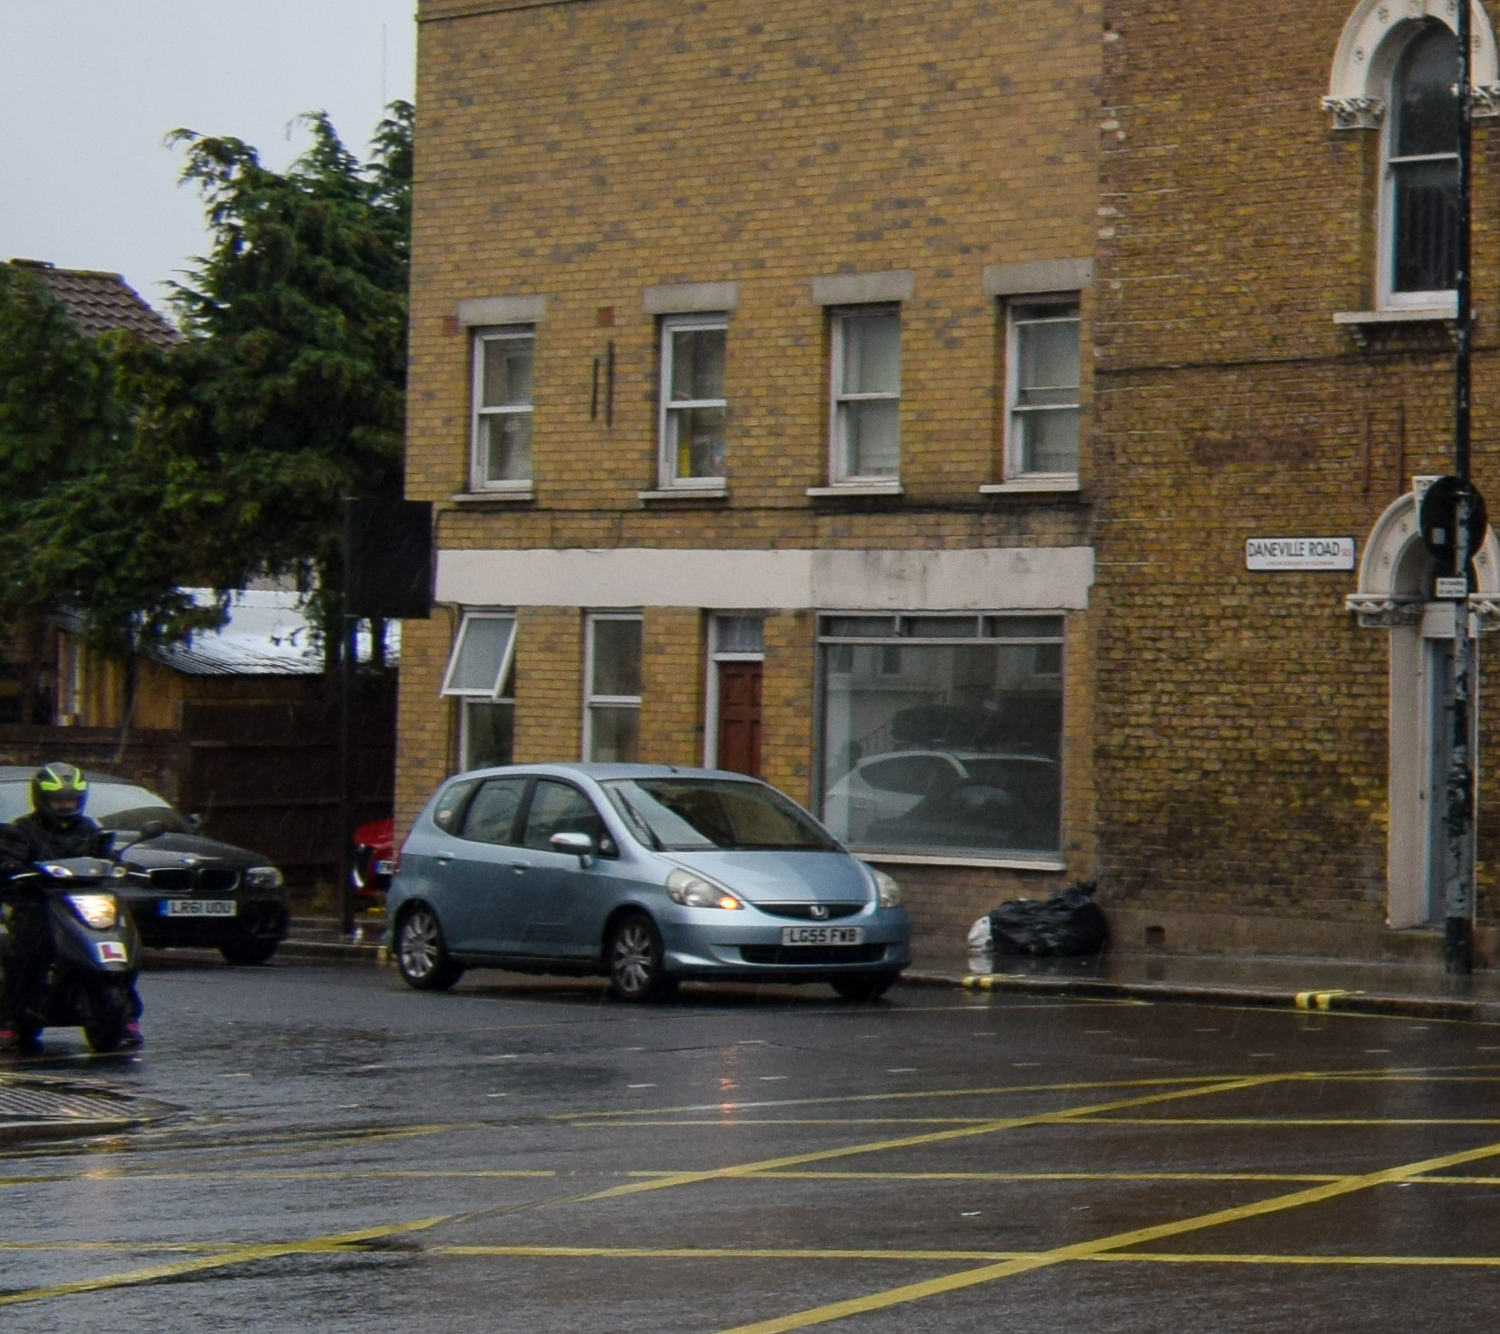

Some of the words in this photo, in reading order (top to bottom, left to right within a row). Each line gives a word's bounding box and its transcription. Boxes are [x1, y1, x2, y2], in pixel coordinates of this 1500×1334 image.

[1248, 541, 1305, 557] DANEVILLE
[1309, 542, 1340, 556] ROAD
[790, 930, 828, 943] LG55
[102, 944, 122, 959] L
